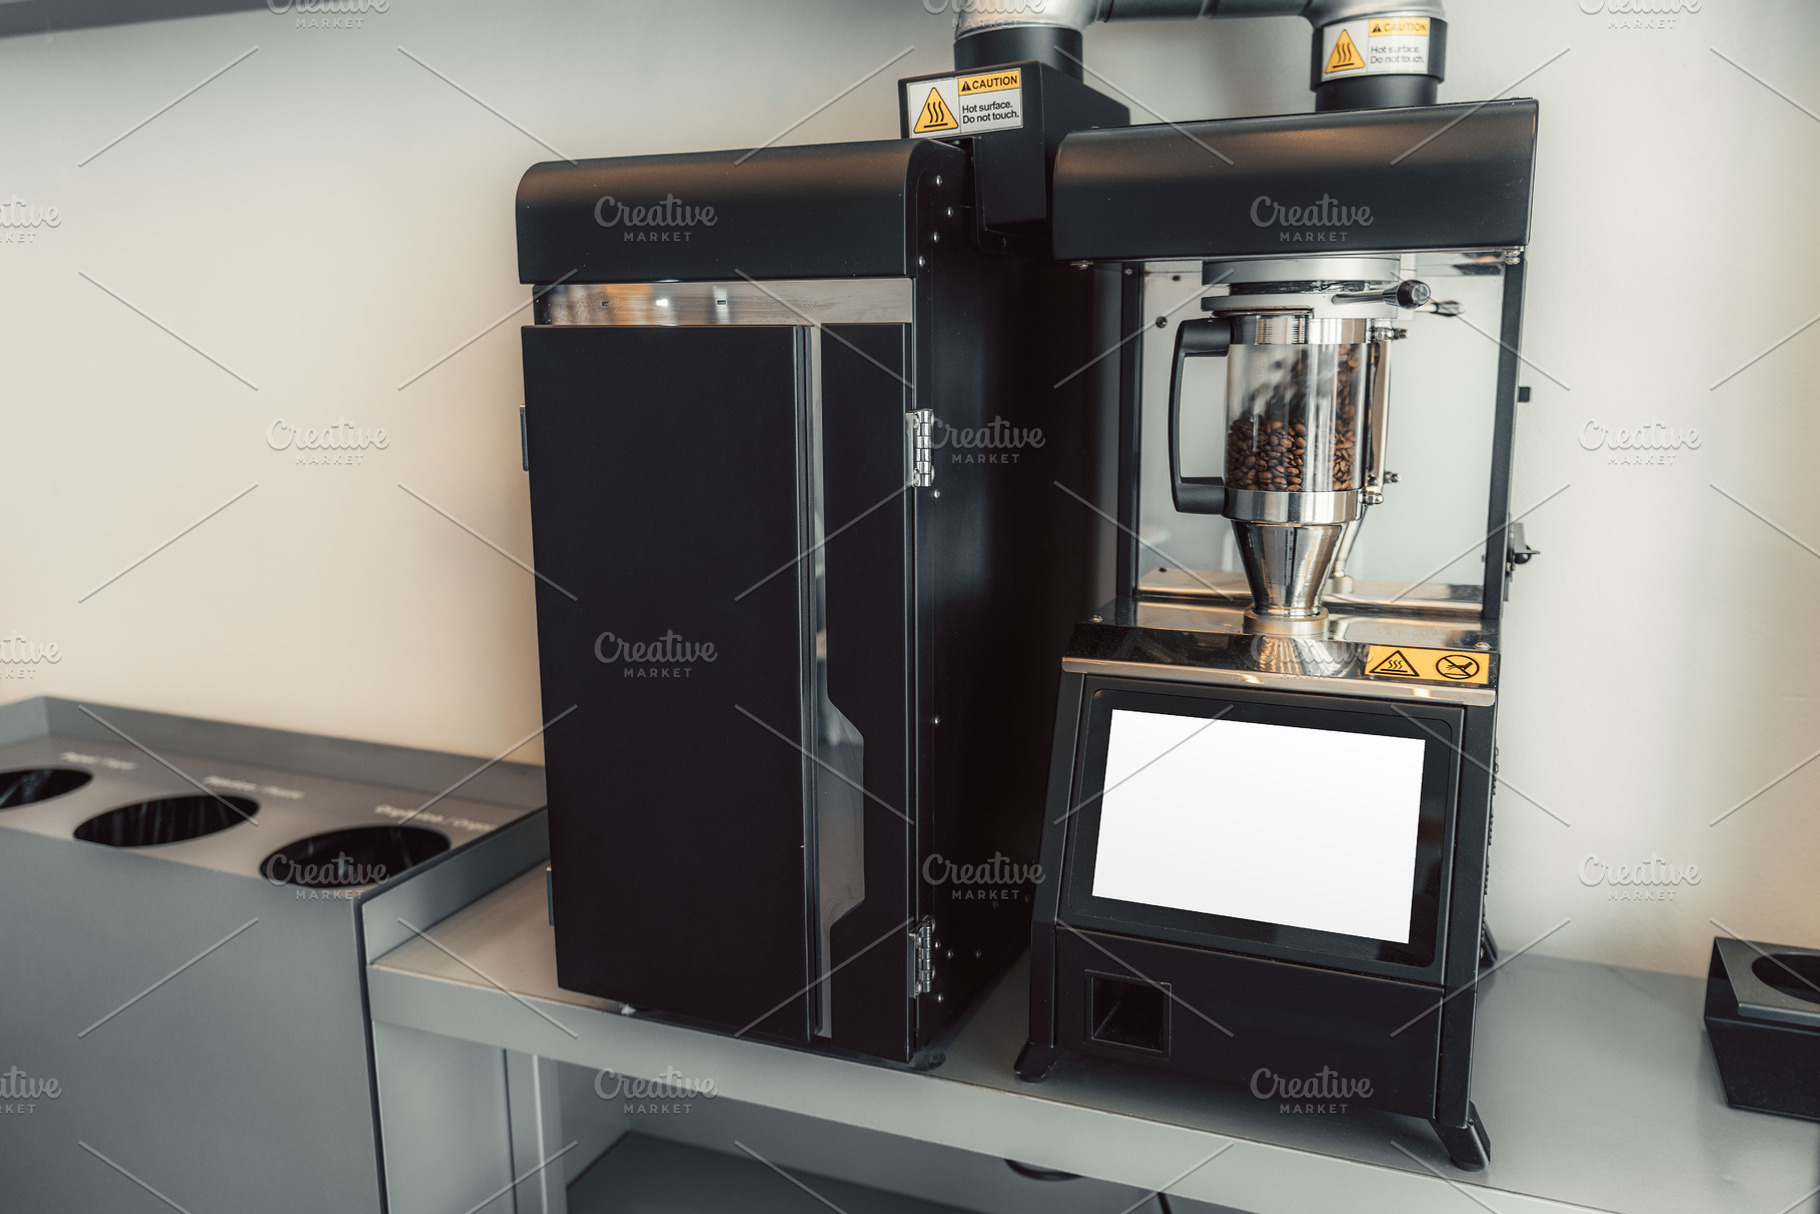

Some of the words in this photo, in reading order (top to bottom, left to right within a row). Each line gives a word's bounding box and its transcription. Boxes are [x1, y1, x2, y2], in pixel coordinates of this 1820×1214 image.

[1370, 45, 1386, 54] Hot
[1370, 55, 1383, 64] Do
[972, 75, 1018, 90] CAUTION
[962, 104, 978, 114] Hot
[979, 101, 1013, 112] surface.
[962, 115, 975, 124] Do
[977, 113, 991, 122] not
[992, 109, 1019, 120] touch.
